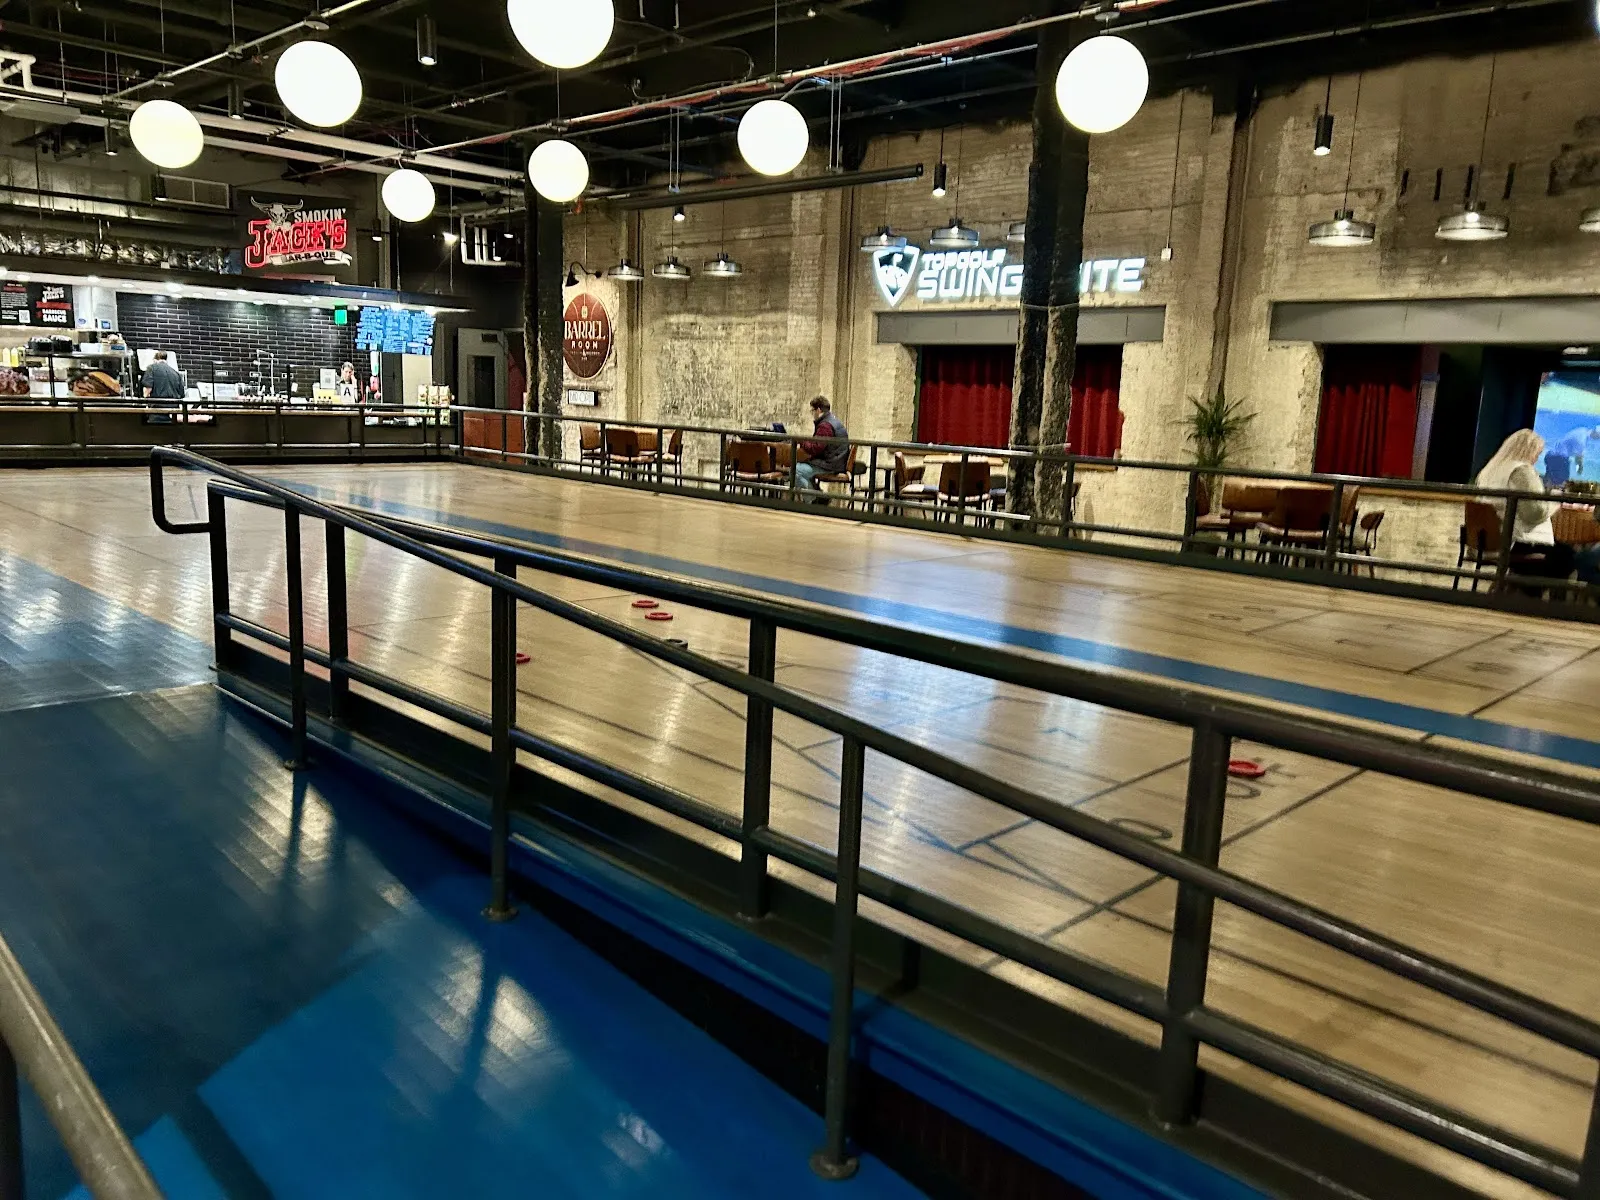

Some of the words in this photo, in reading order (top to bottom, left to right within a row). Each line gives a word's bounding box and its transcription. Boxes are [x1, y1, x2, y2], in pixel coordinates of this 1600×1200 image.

[294, 208, 346, 223] SMOKIN'
[245, 218, 347, 268] JACK'S
[921, 249, 1006, 271] TOPGOLF
[917, 265, 1024, 298] SWING
[1079, 257, 1145, 293] ITE
[43, 314, 67, 323] SAUCE
[564, 320, 606, 340] BARREL
[571, 340, 598, 349] ROOM
[343, 387, 351, 397] A
